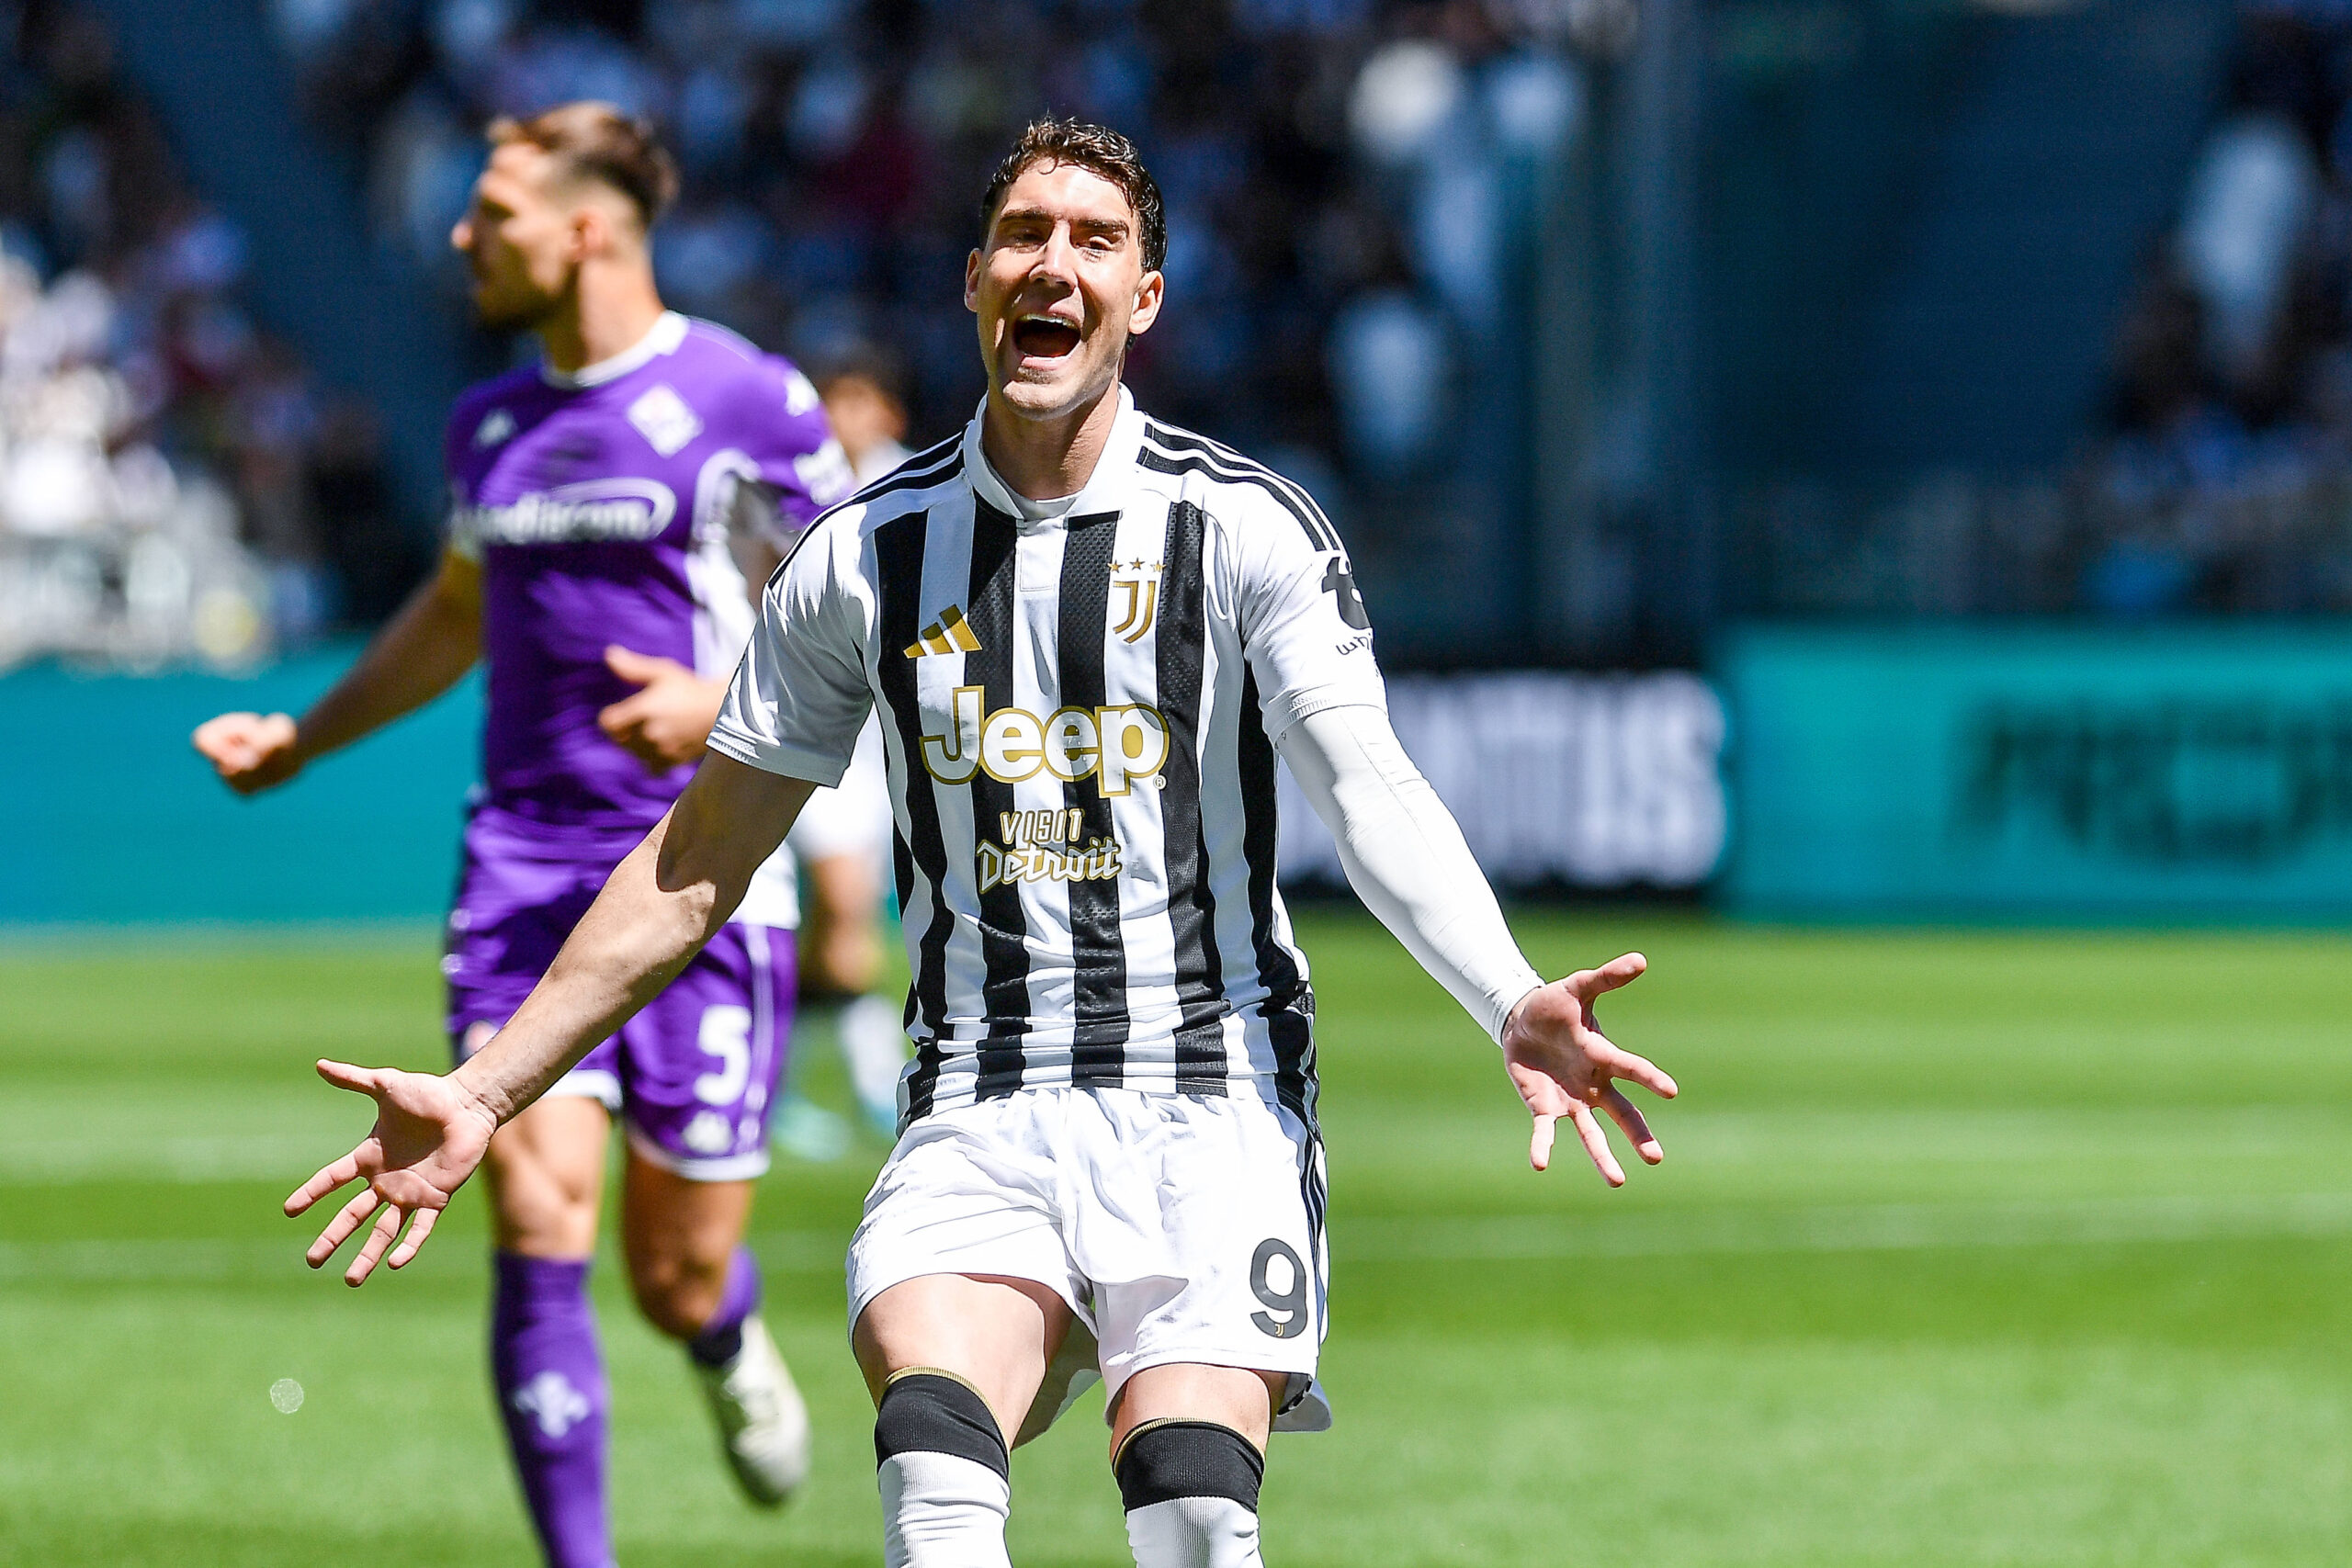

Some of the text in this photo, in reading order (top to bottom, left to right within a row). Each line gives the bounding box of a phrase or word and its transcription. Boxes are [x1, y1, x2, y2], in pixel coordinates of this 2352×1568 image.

[920, 685, 1170, 798] Jeep
[977, 837, 1123, 894] Detroit
[1000, 807, 1085, 844] VISIT
[692, 1004, 752, 1106] 5
[1250, 1237, 1308, 1339] 9
